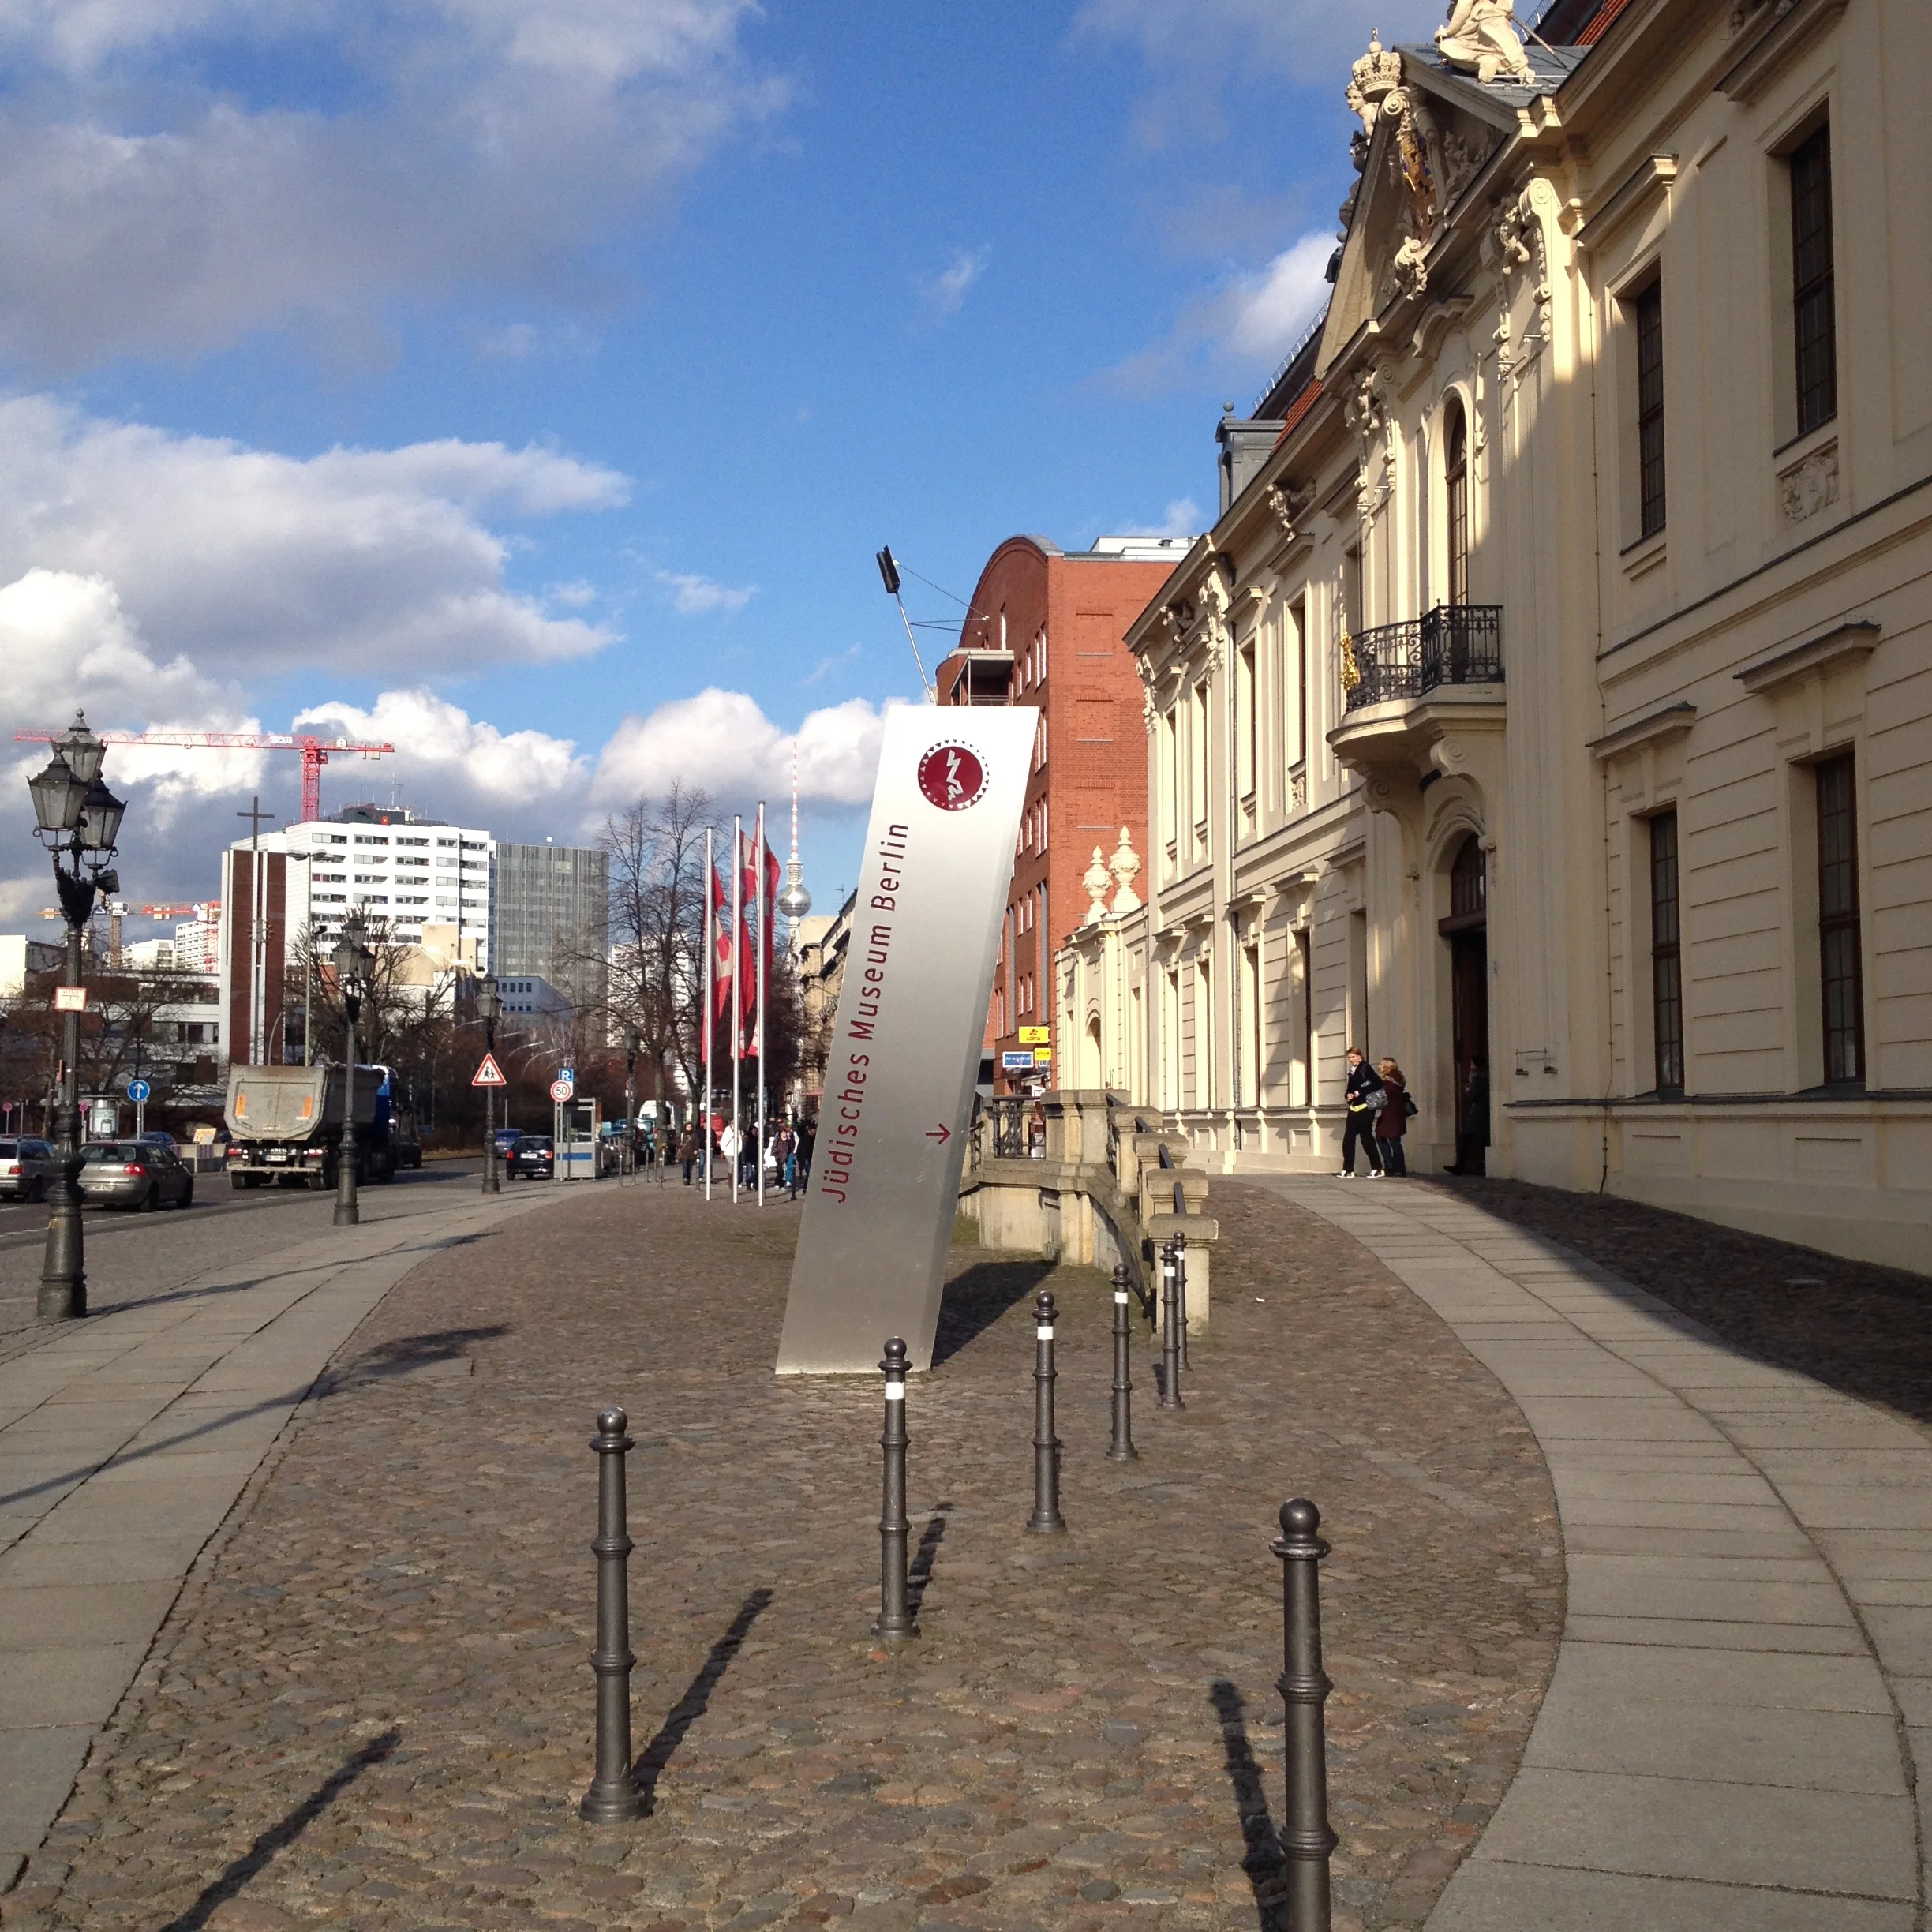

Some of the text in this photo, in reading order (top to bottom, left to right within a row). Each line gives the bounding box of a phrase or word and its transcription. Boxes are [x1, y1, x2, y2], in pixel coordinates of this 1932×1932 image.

[556, 1086, 567, 1095] 50
[822, 824, 909, 1204] Jüdisches Museum Berlin
